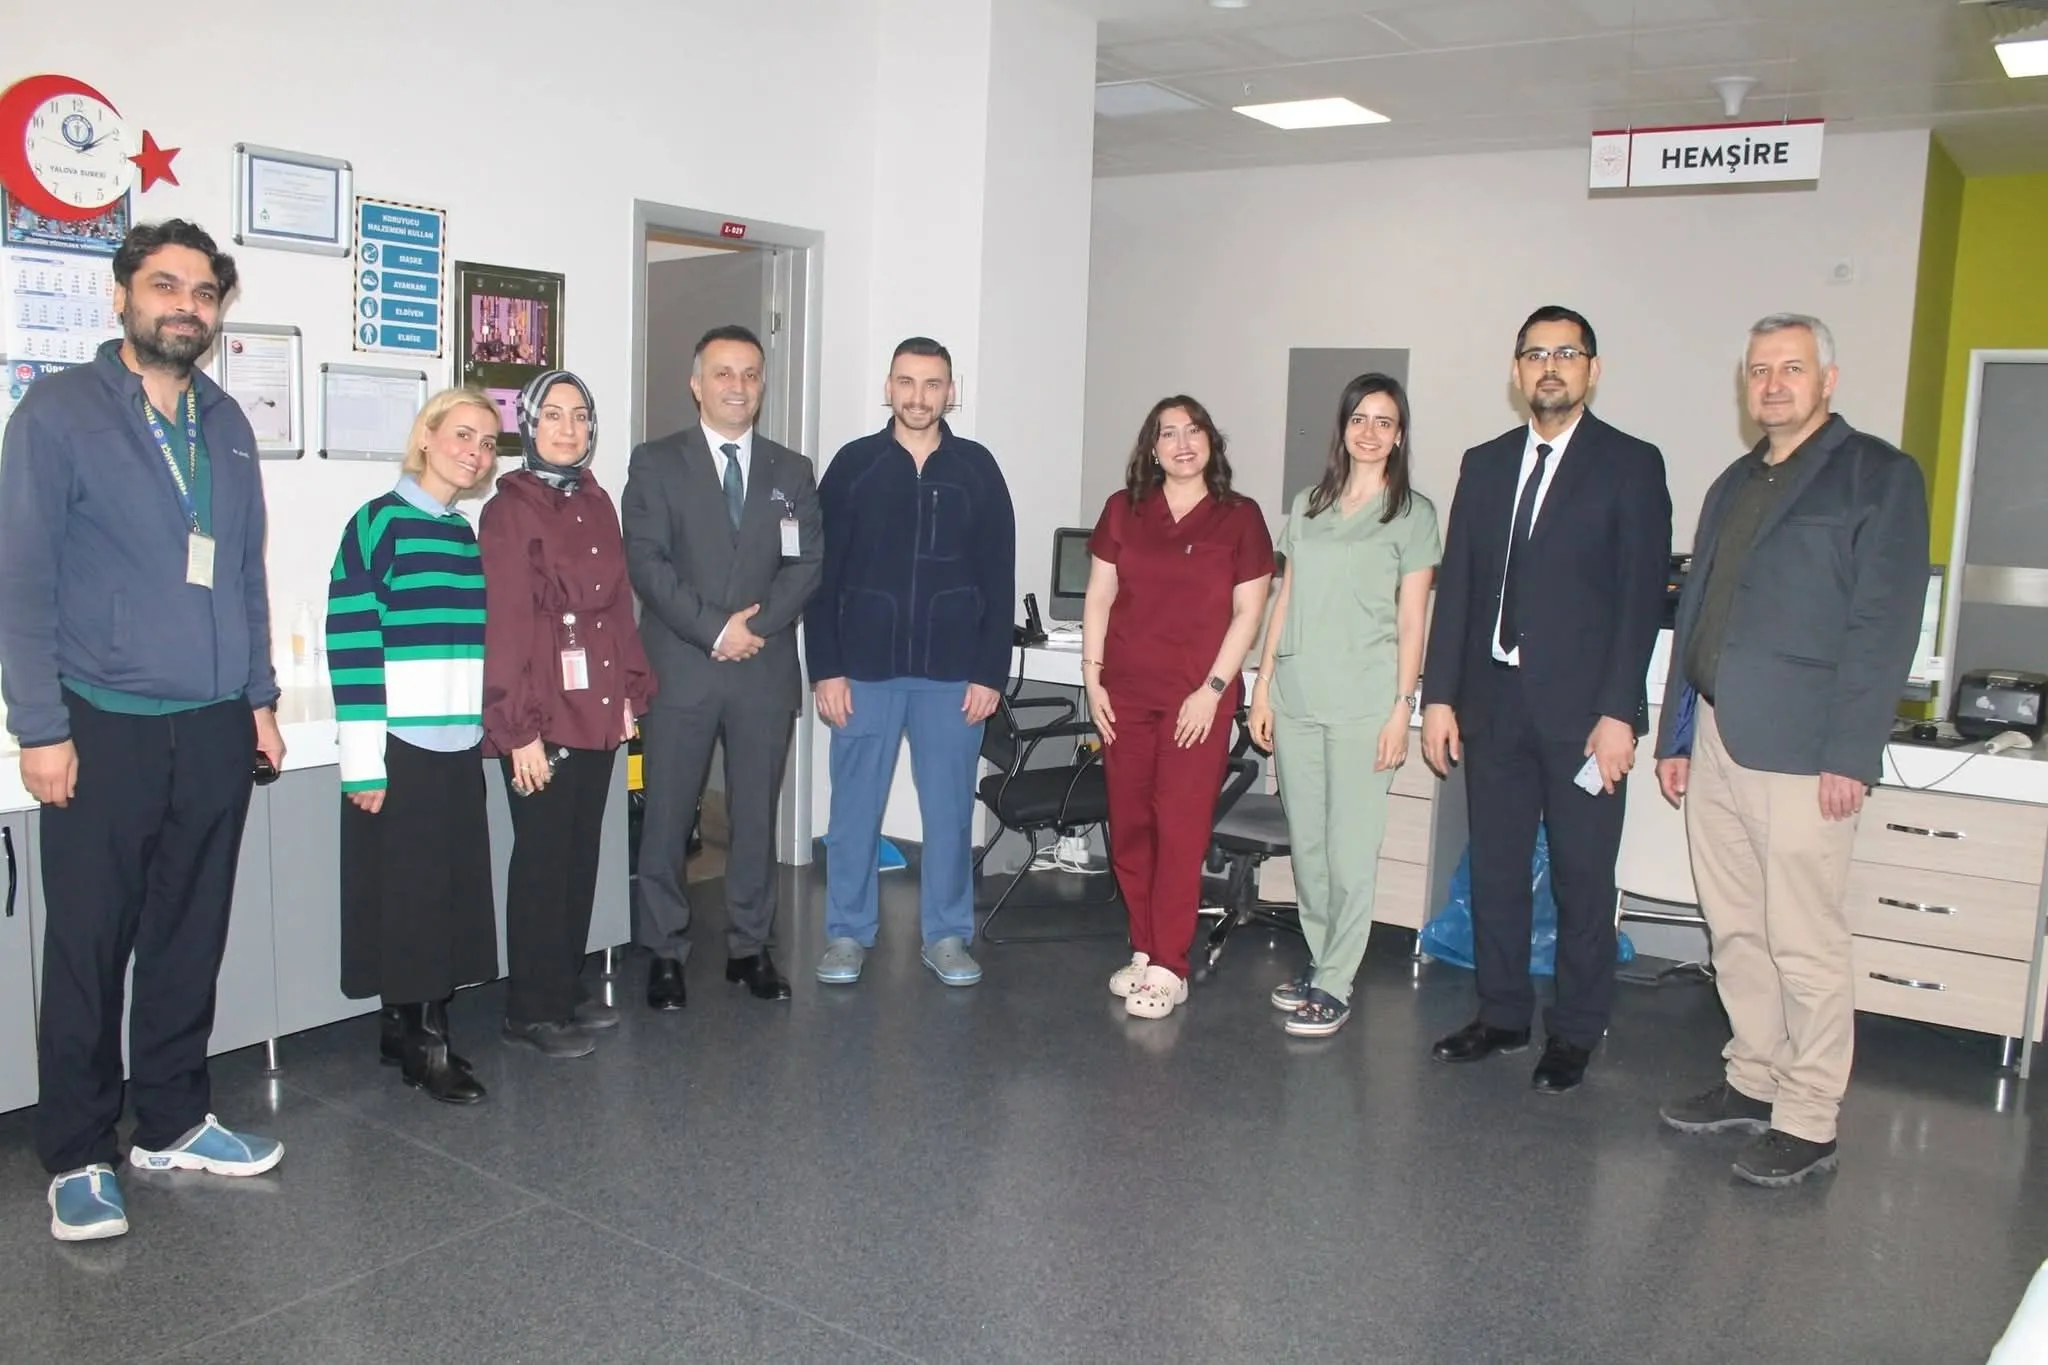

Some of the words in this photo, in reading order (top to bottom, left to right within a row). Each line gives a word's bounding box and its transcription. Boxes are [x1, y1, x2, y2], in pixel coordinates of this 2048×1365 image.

[1661, 137, 1790, 174] HEMŞİRE
[50, 165, 79, 176] YALOVA
[382, 214, 420, 227] KORUYUCU
[407, 229, 434, 240] KULLAN
[399, 255, 423, 265] MASKE
[393, 280, 427, 292] AYAKKABI
[395, 306, 424, 318] ELDİVEN
